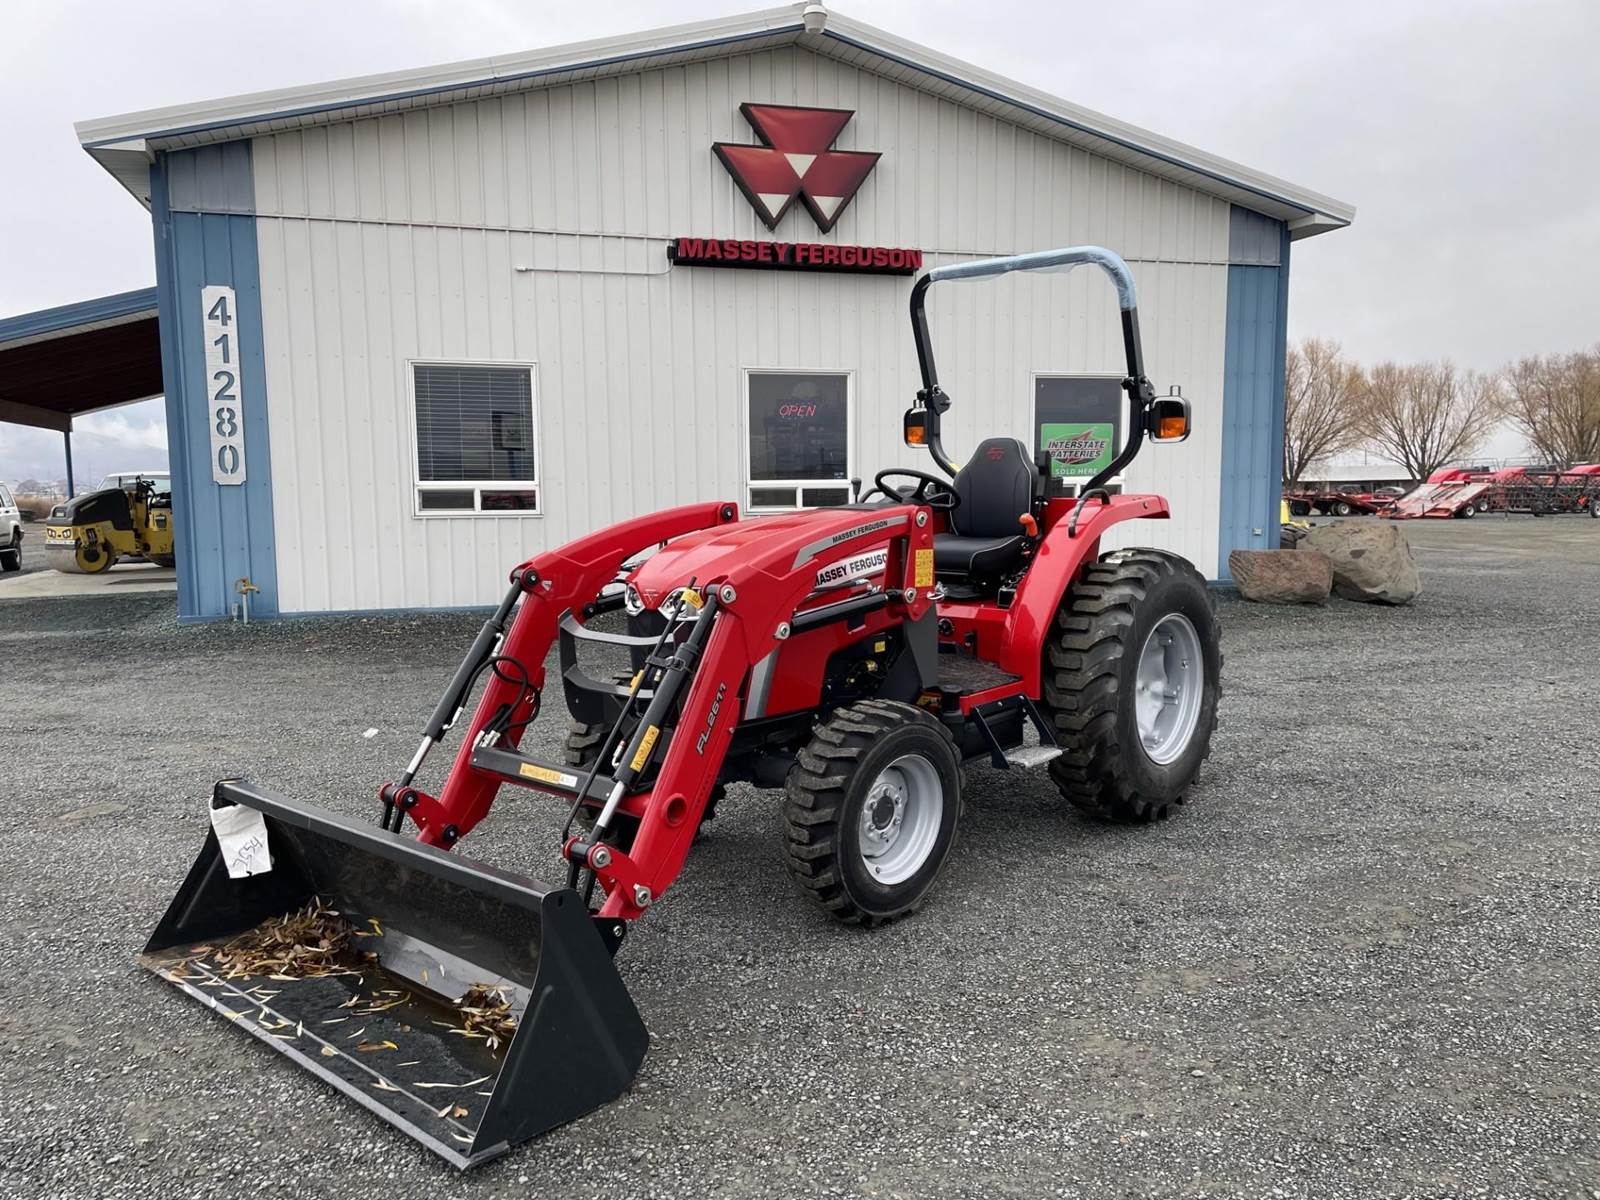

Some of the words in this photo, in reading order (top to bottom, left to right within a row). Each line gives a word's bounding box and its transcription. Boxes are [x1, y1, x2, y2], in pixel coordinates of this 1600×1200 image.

[679, 237, 789, 262] MASSEY
[794, 242, 923, 270] FERGUSON
[207, 295, 240, 475] 41280
[779, 404, 817, 417] OPEN
[1048, 440, 1105, 449] INTERSTATE
[1049, 450, 1102, 458] BATTERIES
[832, 529, 857, 543] MASSEY
[857, 520, 888, 536] FERGUSON
